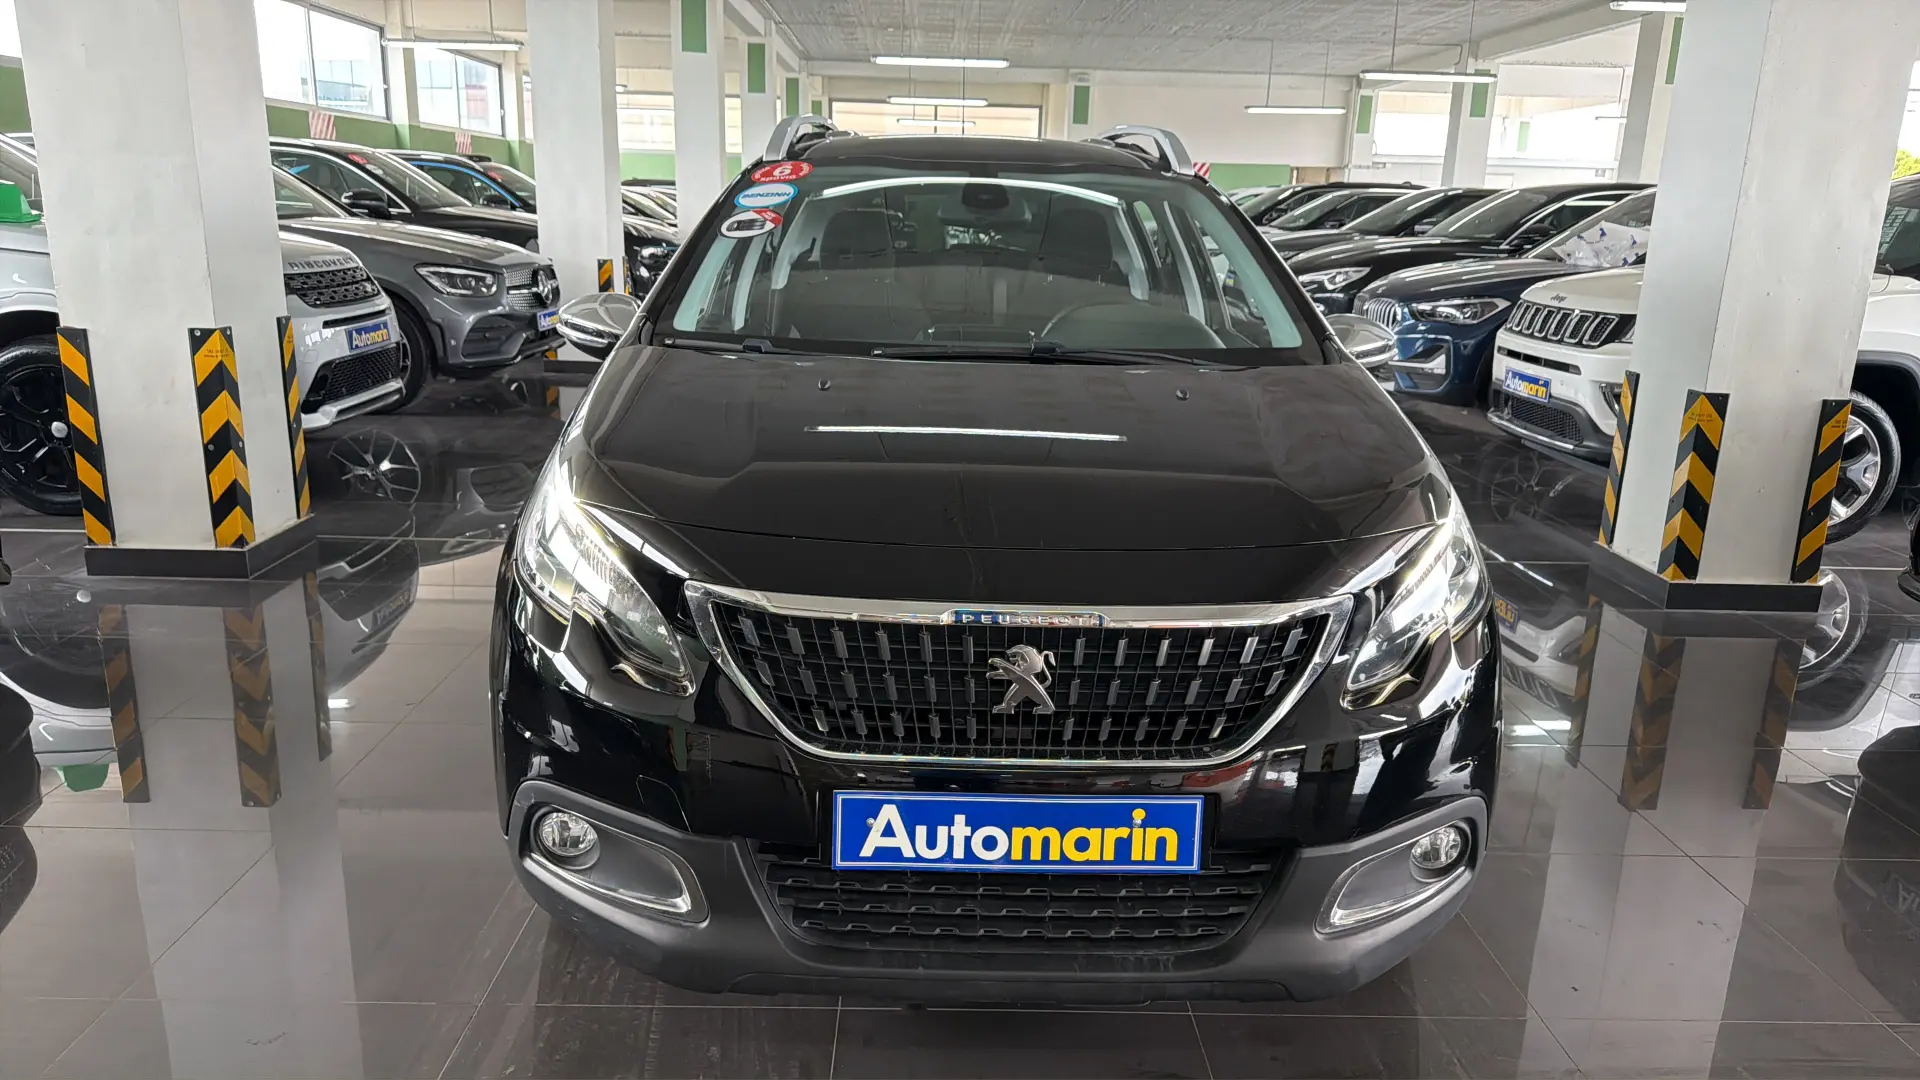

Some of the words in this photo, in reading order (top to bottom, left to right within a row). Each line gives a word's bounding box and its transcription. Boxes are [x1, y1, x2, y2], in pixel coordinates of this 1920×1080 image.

[773, 165, 793, 176] 6
[352, 324, 389, 348] Automarin
[1505, 371, 1547, 398] Automarin
[962, 613, 1087, 626] PEUGEOT
[858, 803, 1178, 862] Automarin
